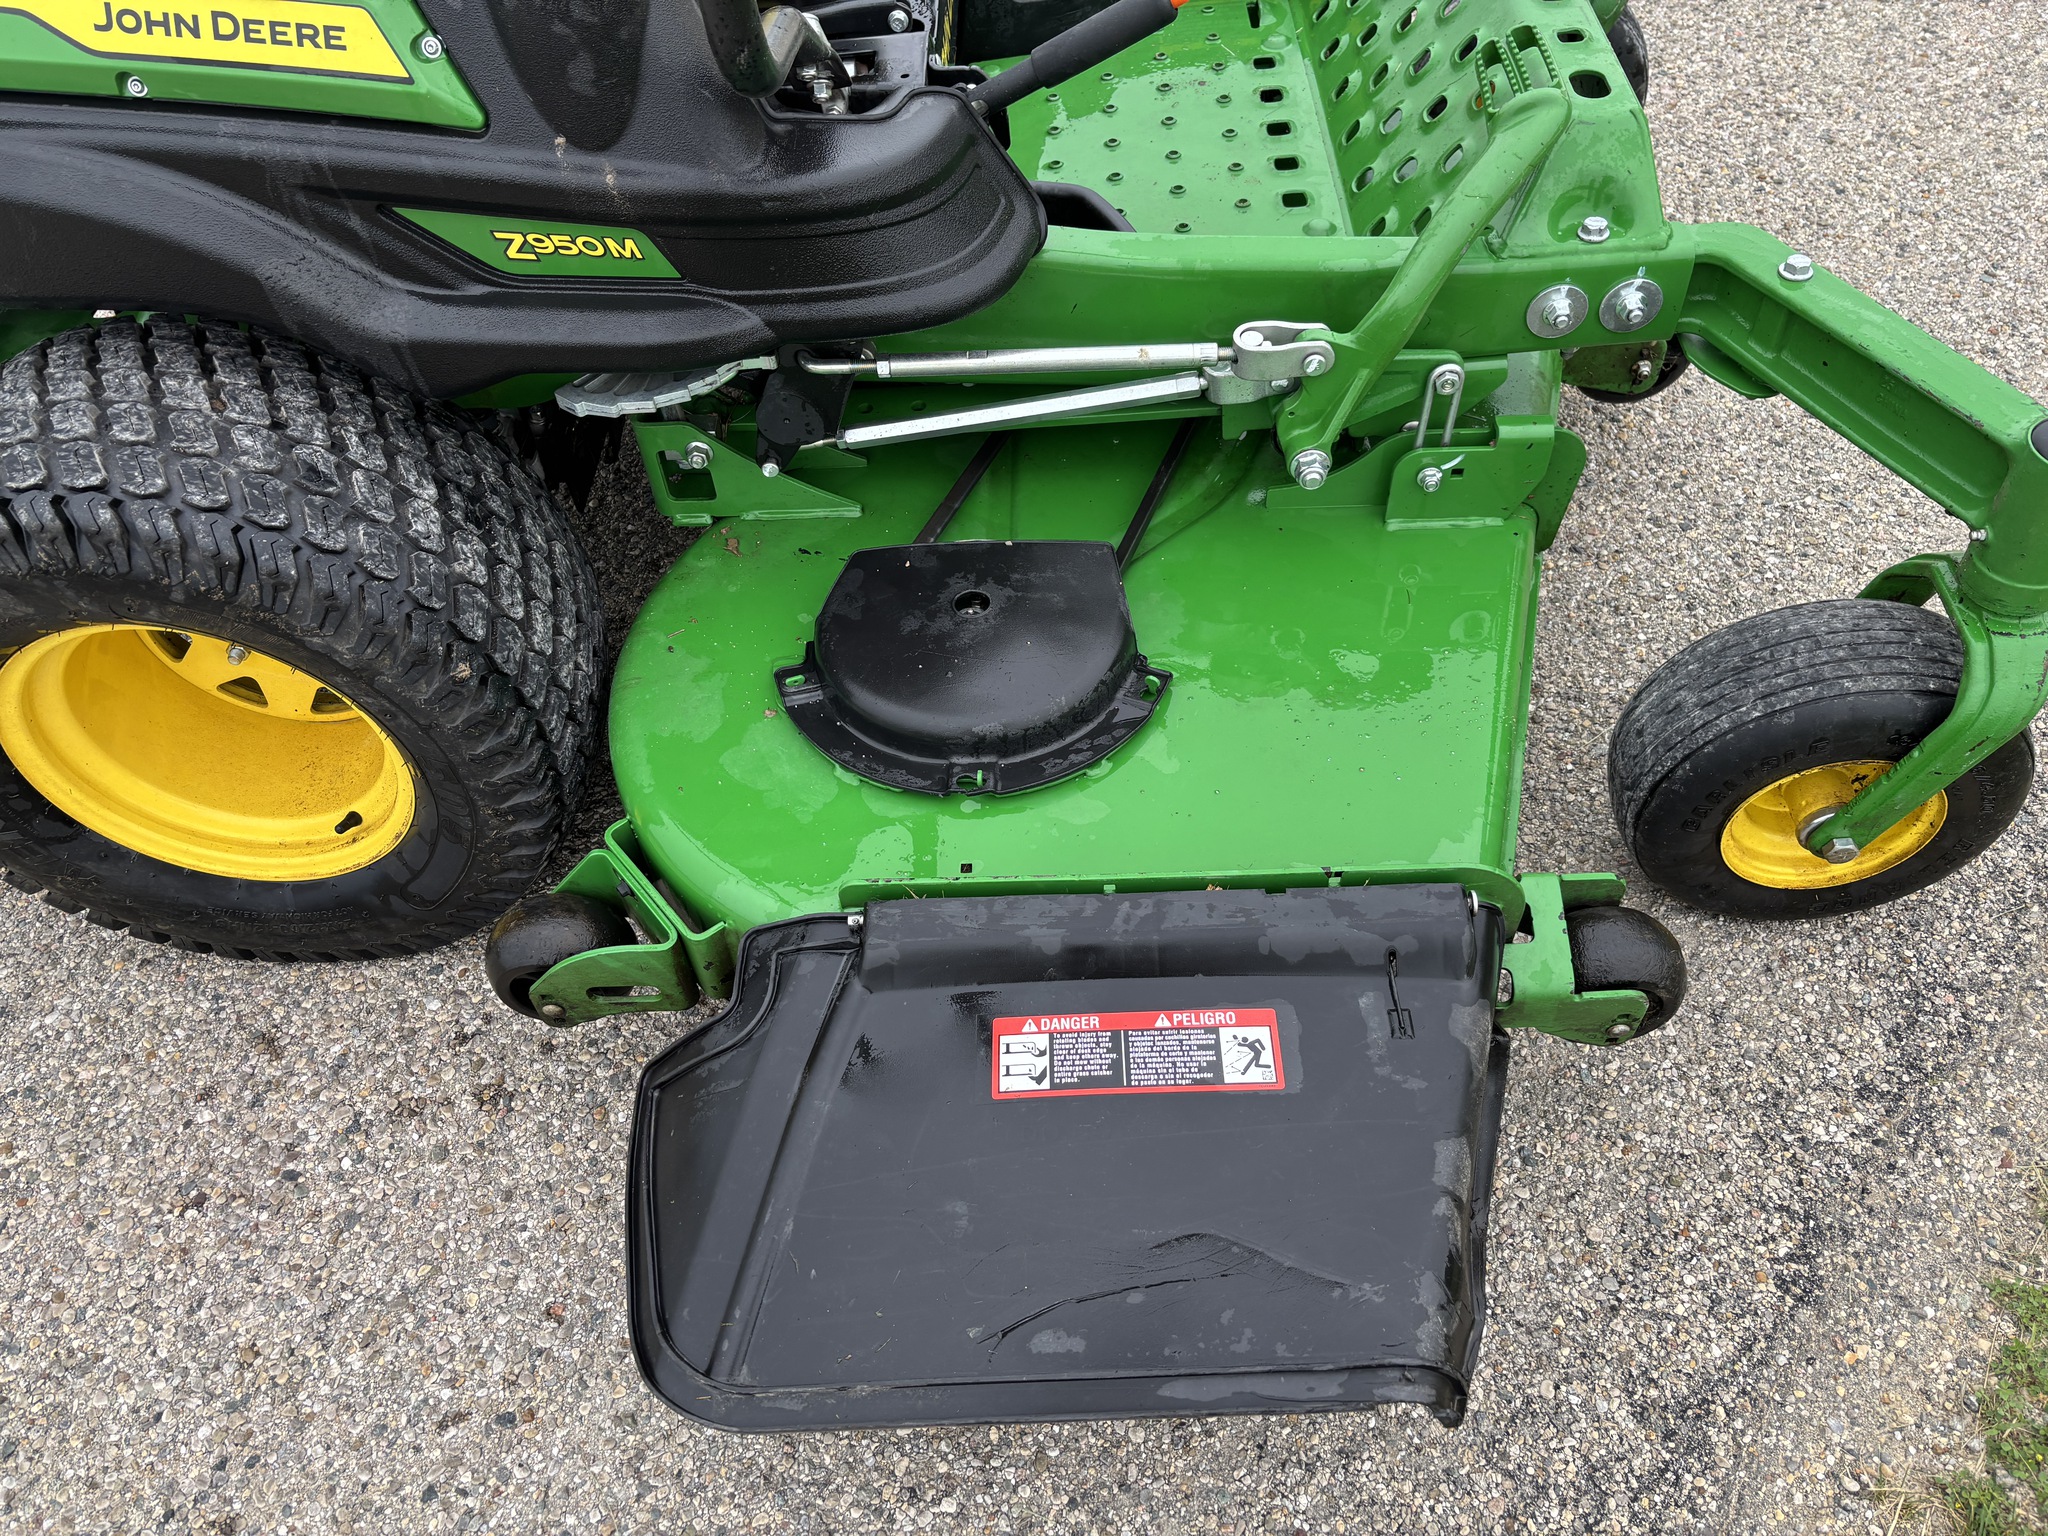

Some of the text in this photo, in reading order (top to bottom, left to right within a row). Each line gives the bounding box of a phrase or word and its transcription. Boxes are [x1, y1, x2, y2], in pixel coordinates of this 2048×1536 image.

[94, 2, 347, 51] JOHN DEERE
[491, 231, 645, 262] Z950M
[1041, 1016, 1099, 1030] DANGER
[1173, 1011, 1236, 1026] PELIGRO
